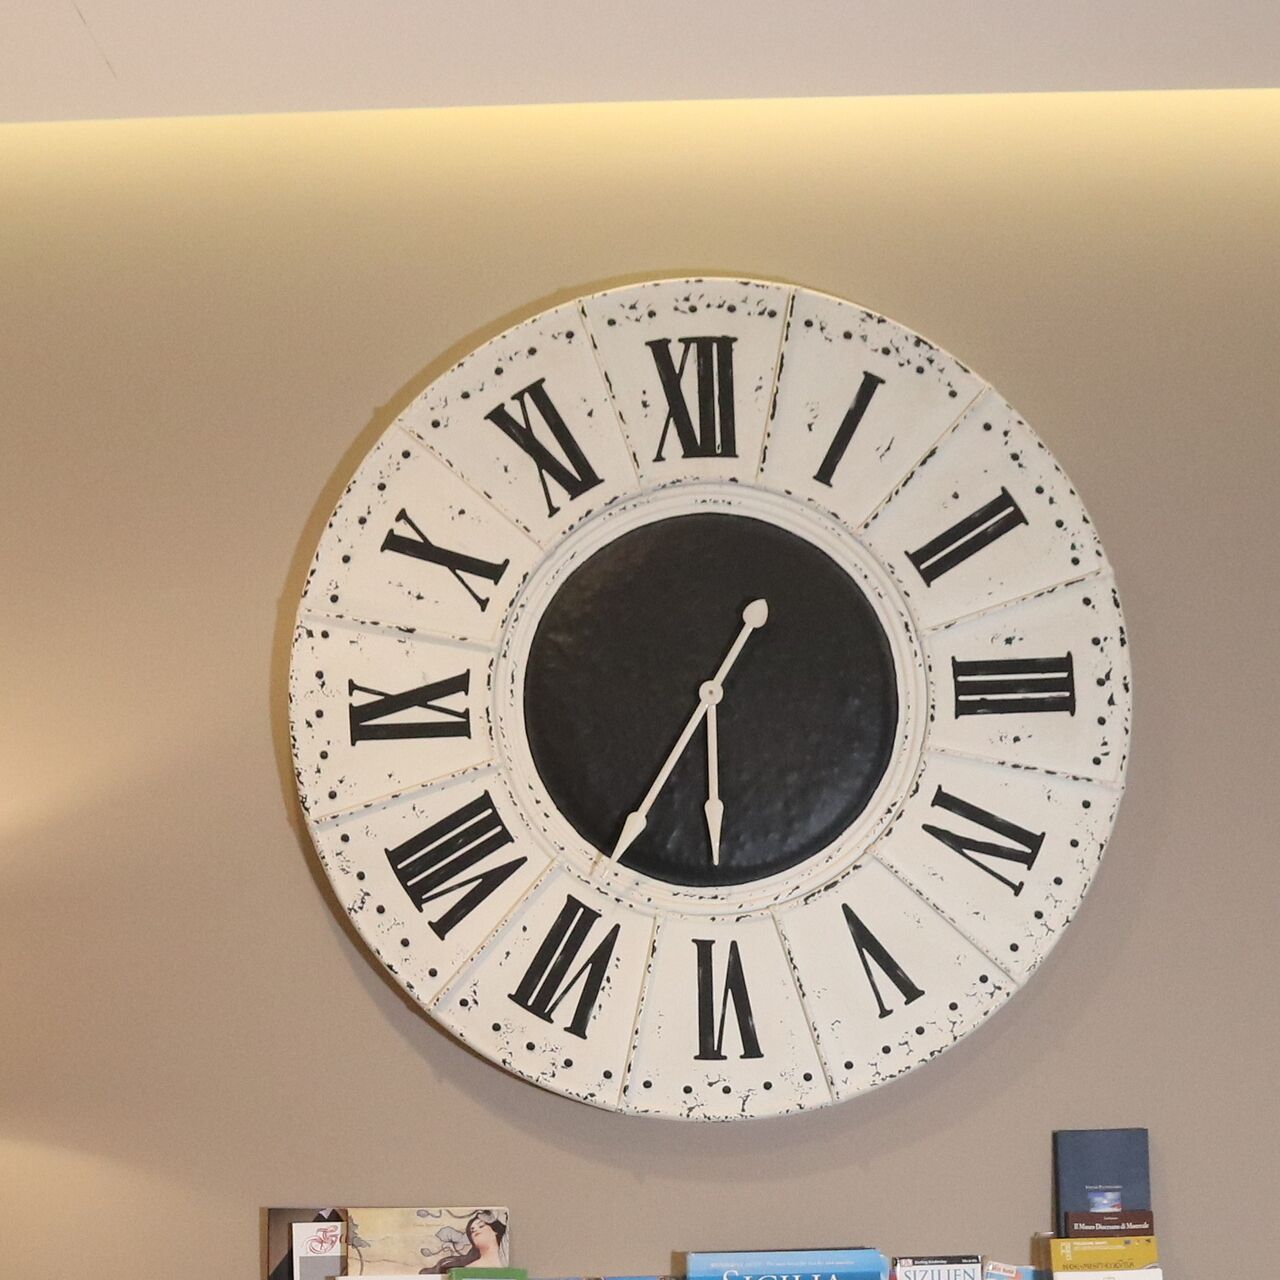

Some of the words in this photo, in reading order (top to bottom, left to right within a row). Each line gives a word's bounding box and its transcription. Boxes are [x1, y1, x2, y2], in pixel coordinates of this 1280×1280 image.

[484, 378, 604, 518] XI
[645, 336, 738, 462] XII
[381, 509, 509, 612] X
[349, 669, 471, 746] IX
[952, 652, 1075, 719] III
[922, 785, 1045, 896] IV
[508, 895, 620, 1039] VII
[692, 939, 763, 1060] VI
[842, 904, 925, 1018] V
